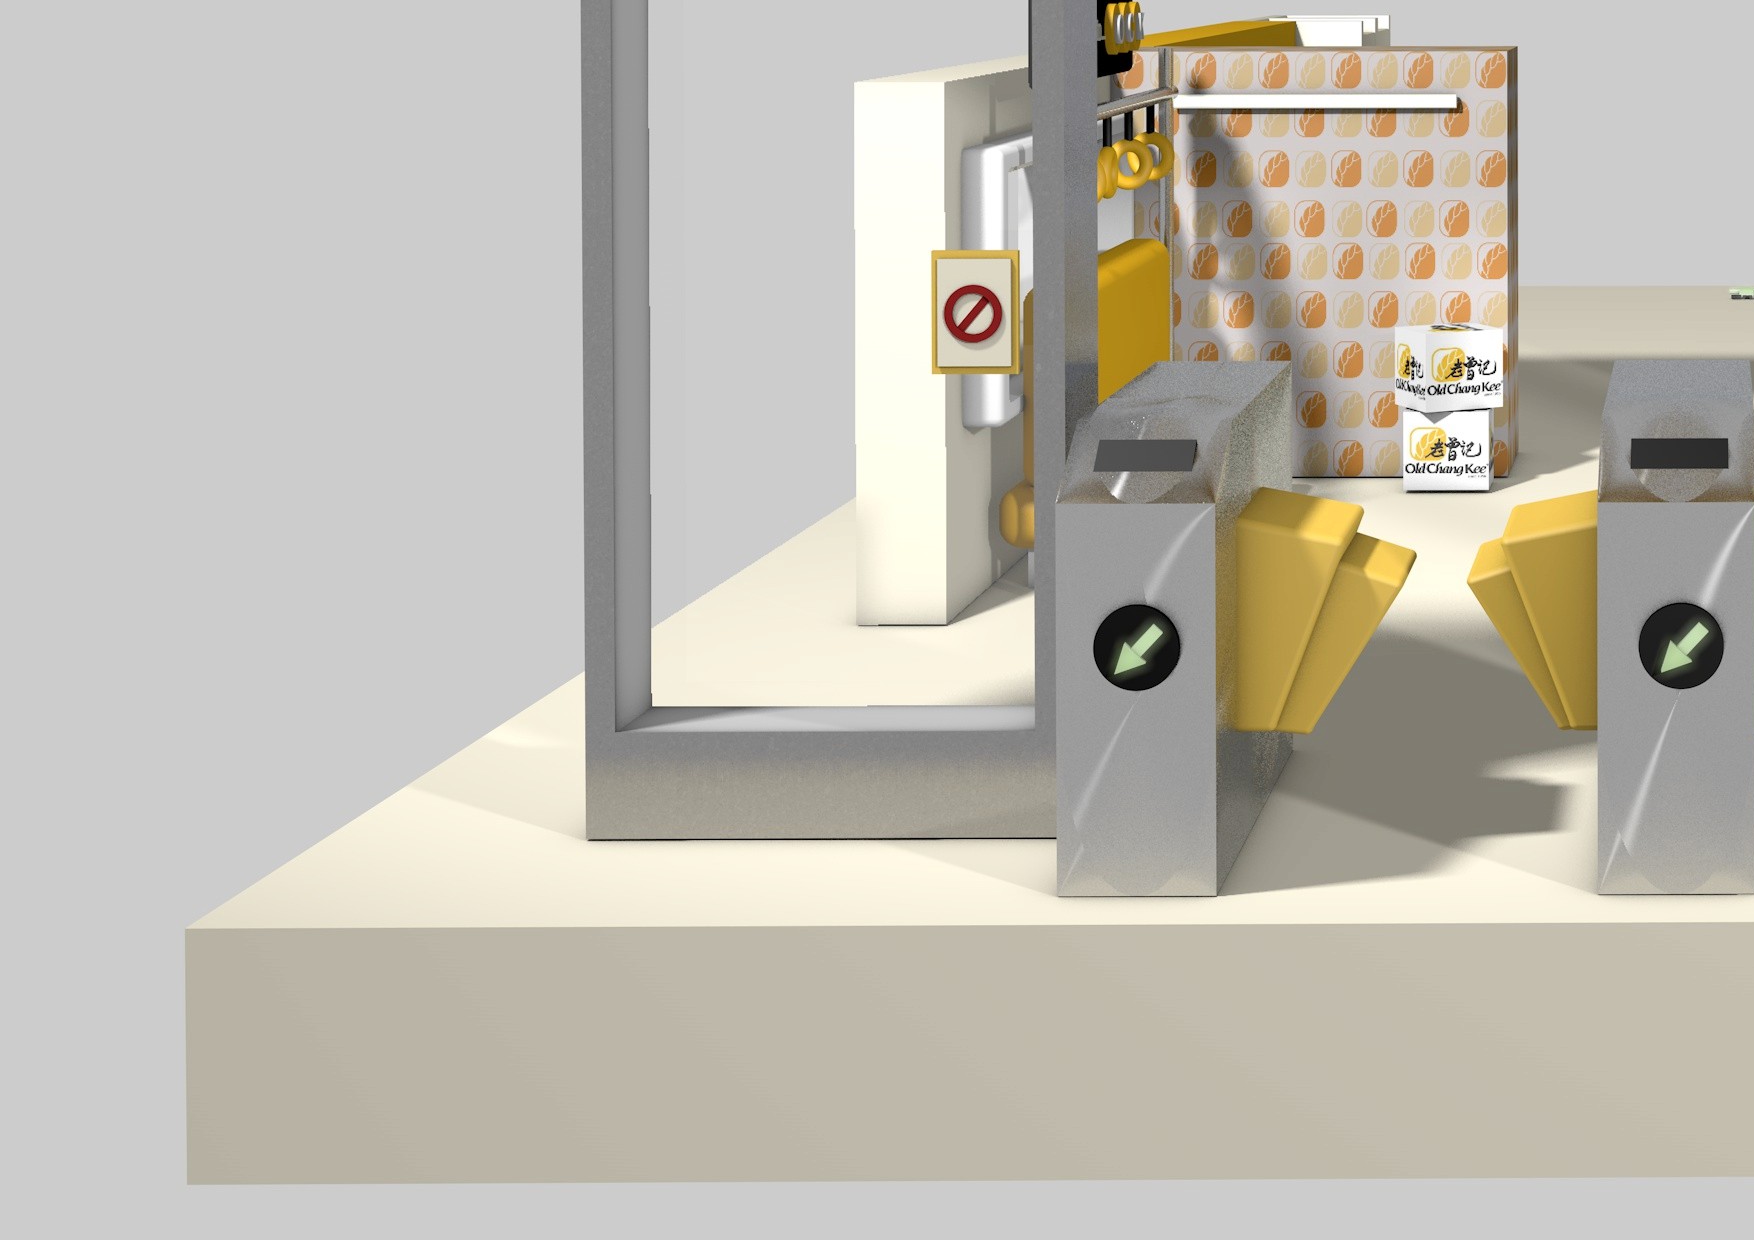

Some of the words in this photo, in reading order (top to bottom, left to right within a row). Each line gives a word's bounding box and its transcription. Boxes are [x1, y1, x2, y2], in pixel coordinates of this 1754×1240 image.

[1427, 383, 1447, 396] Old
[1447, 382, 1481, 396] Chang
[1482, 381, 1501, 392] Kee
[1405, 462, 1426, 474] Old
[1426, 462, 1464, 476] Chang
[1465, 463, 1487, 474] Kee
